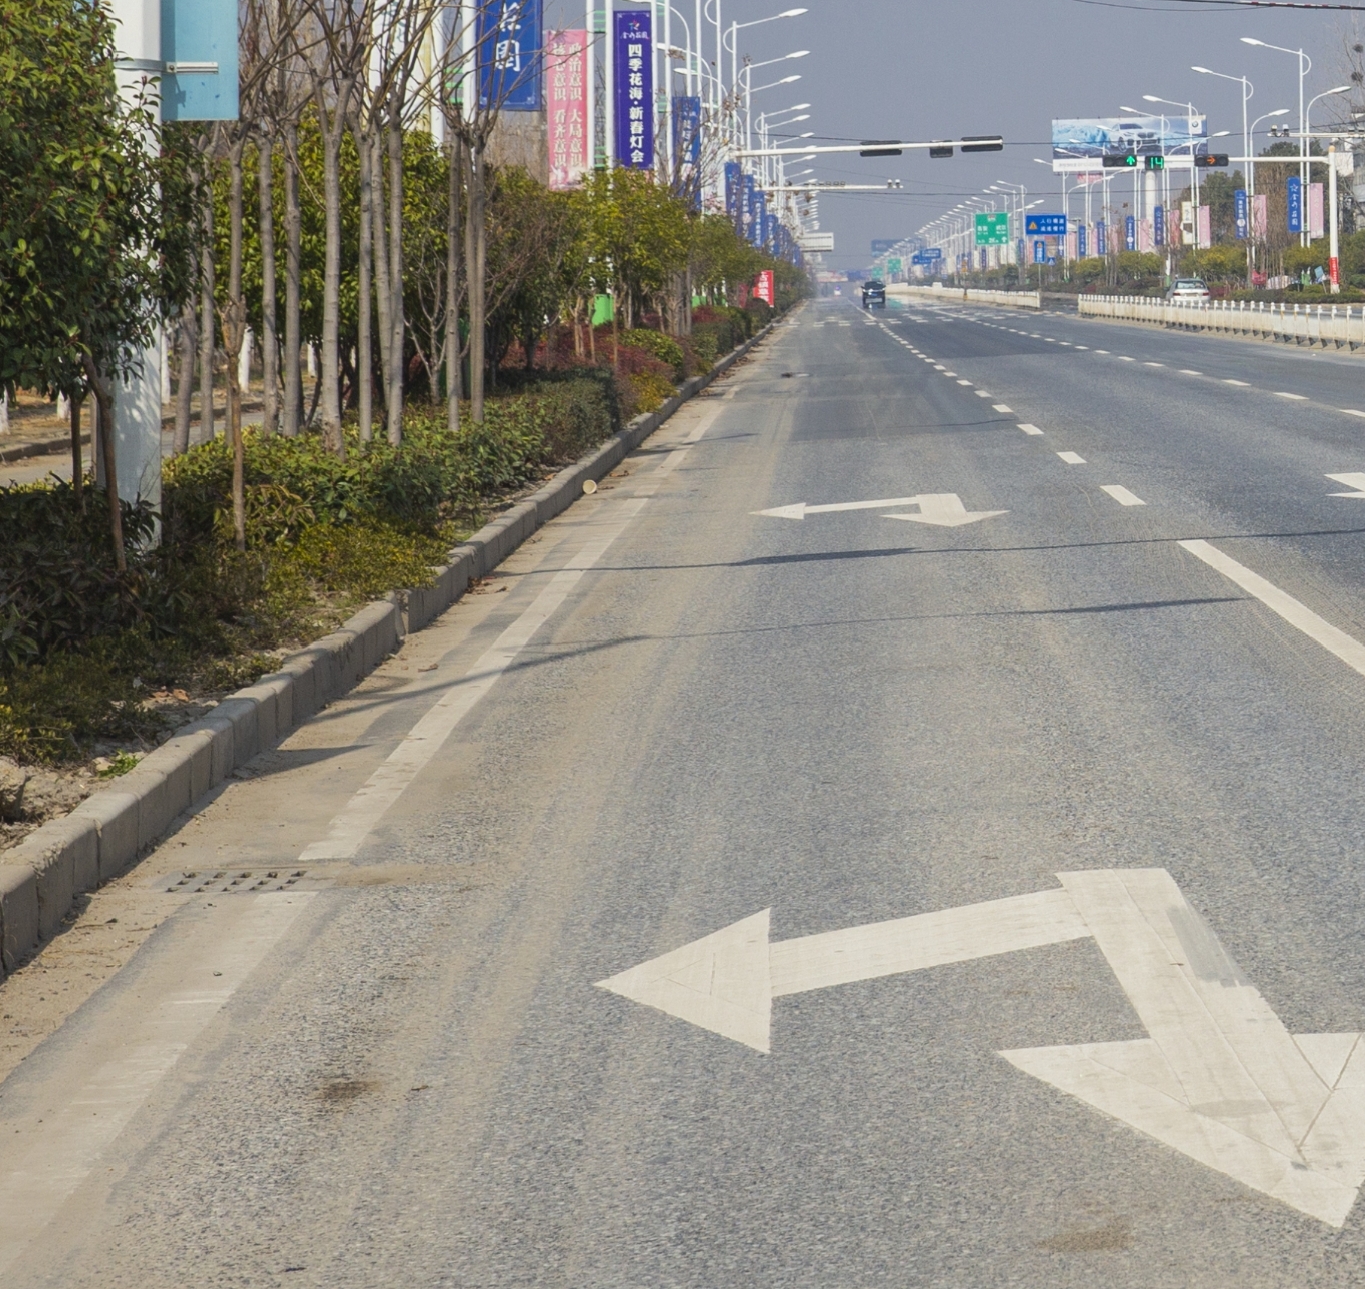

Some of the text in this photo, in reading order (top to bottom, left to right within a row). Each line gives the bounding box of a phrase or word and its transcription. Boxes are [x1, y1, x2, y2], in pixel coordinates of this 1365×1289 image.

[553, 43, 567, 167] 核心意识 看齐意识
[569, 42, 582, 167] 政治意识 大局意识
[628, 43, 644, 163] 四季花海·新春灯会
[1150, 157, 1164, 169] 14
